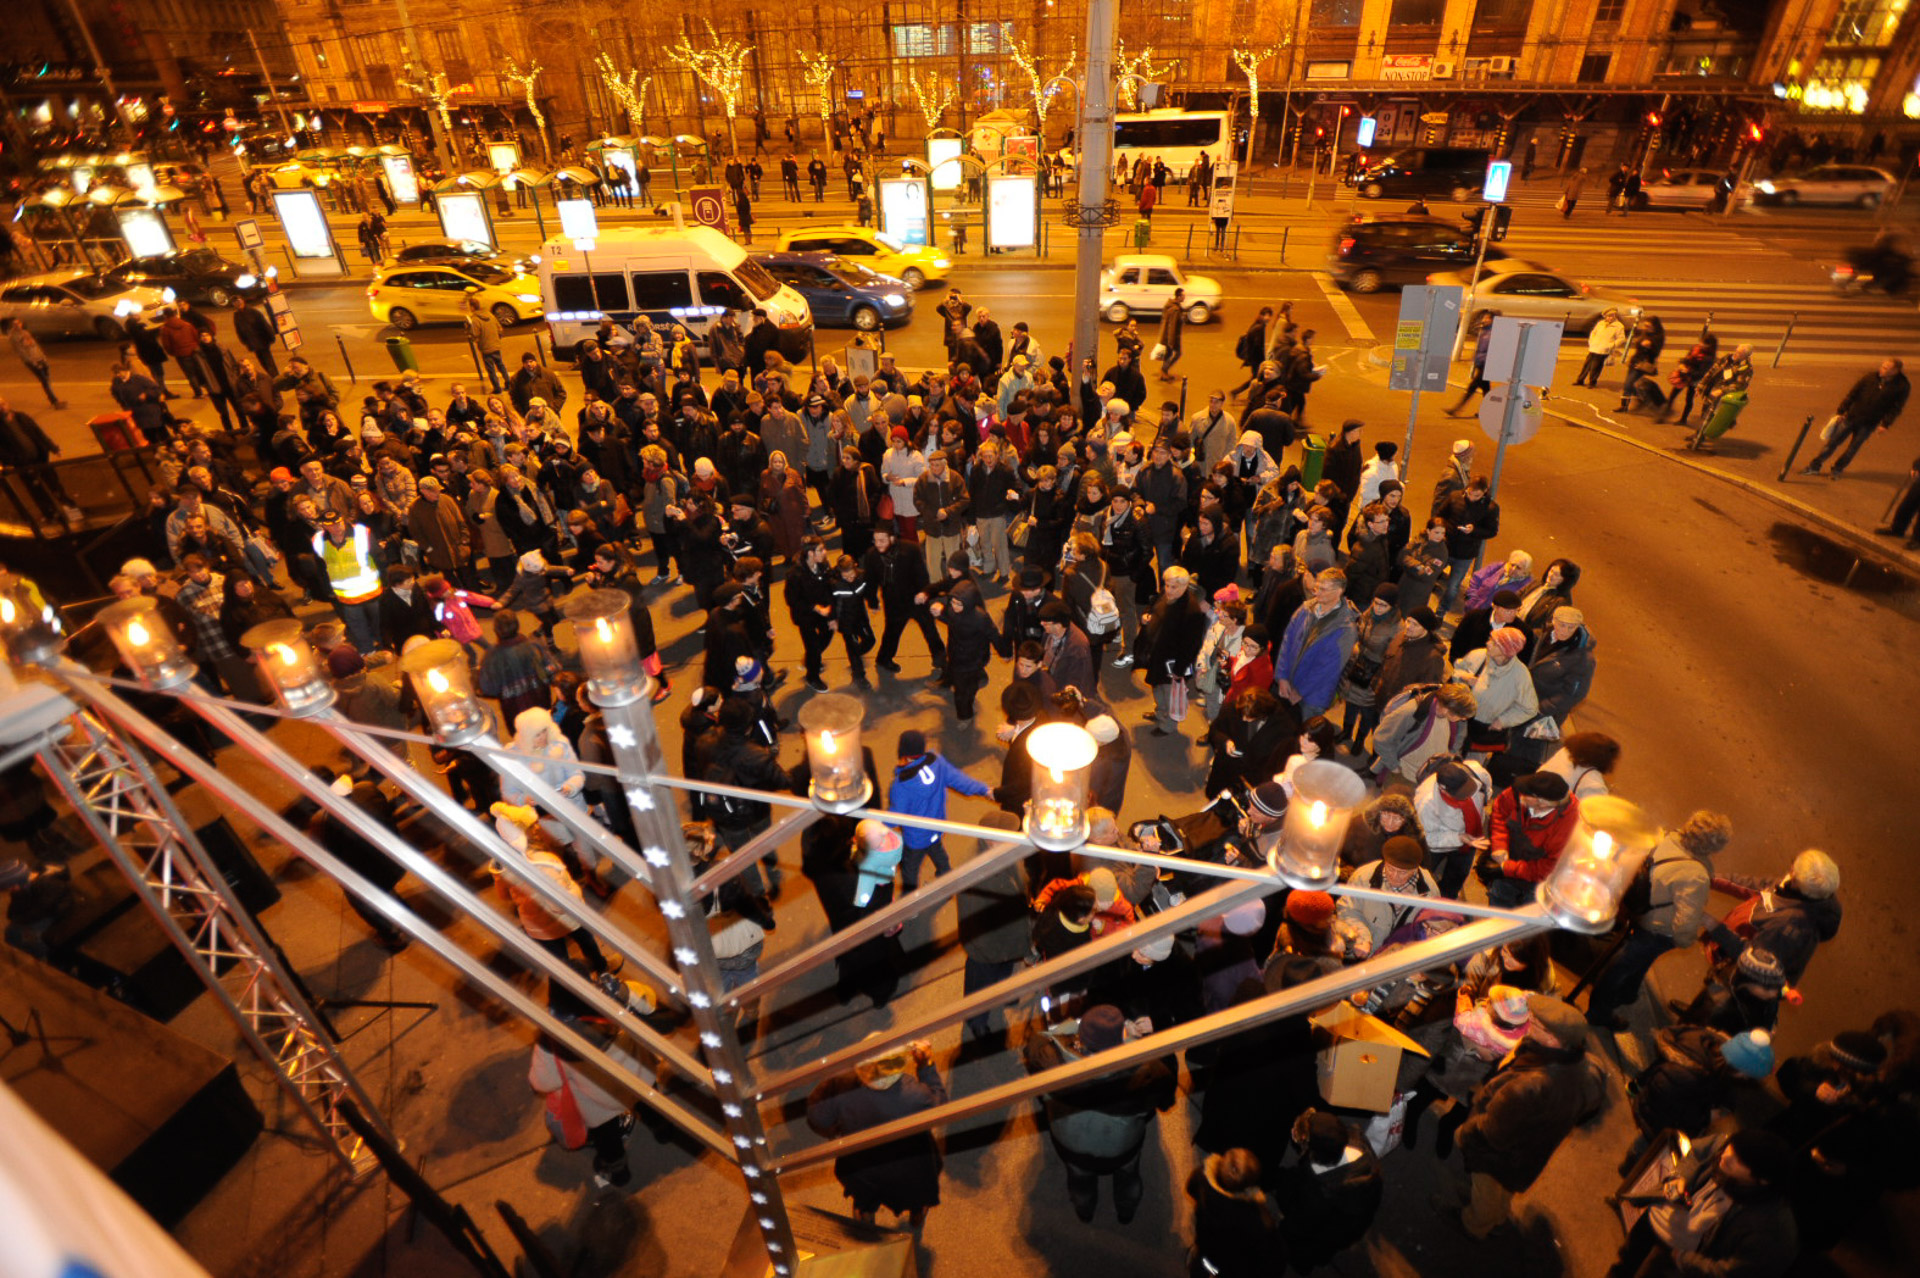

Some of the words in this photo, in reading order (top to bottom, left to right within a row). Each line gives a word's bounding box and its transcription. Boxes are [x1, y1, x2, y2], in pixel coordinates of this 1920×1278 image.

[1385, 71, 1428, 81] NON-STOP
[1378, 128, 1391, 136] 24
[551, 246, 562, 255] T2
